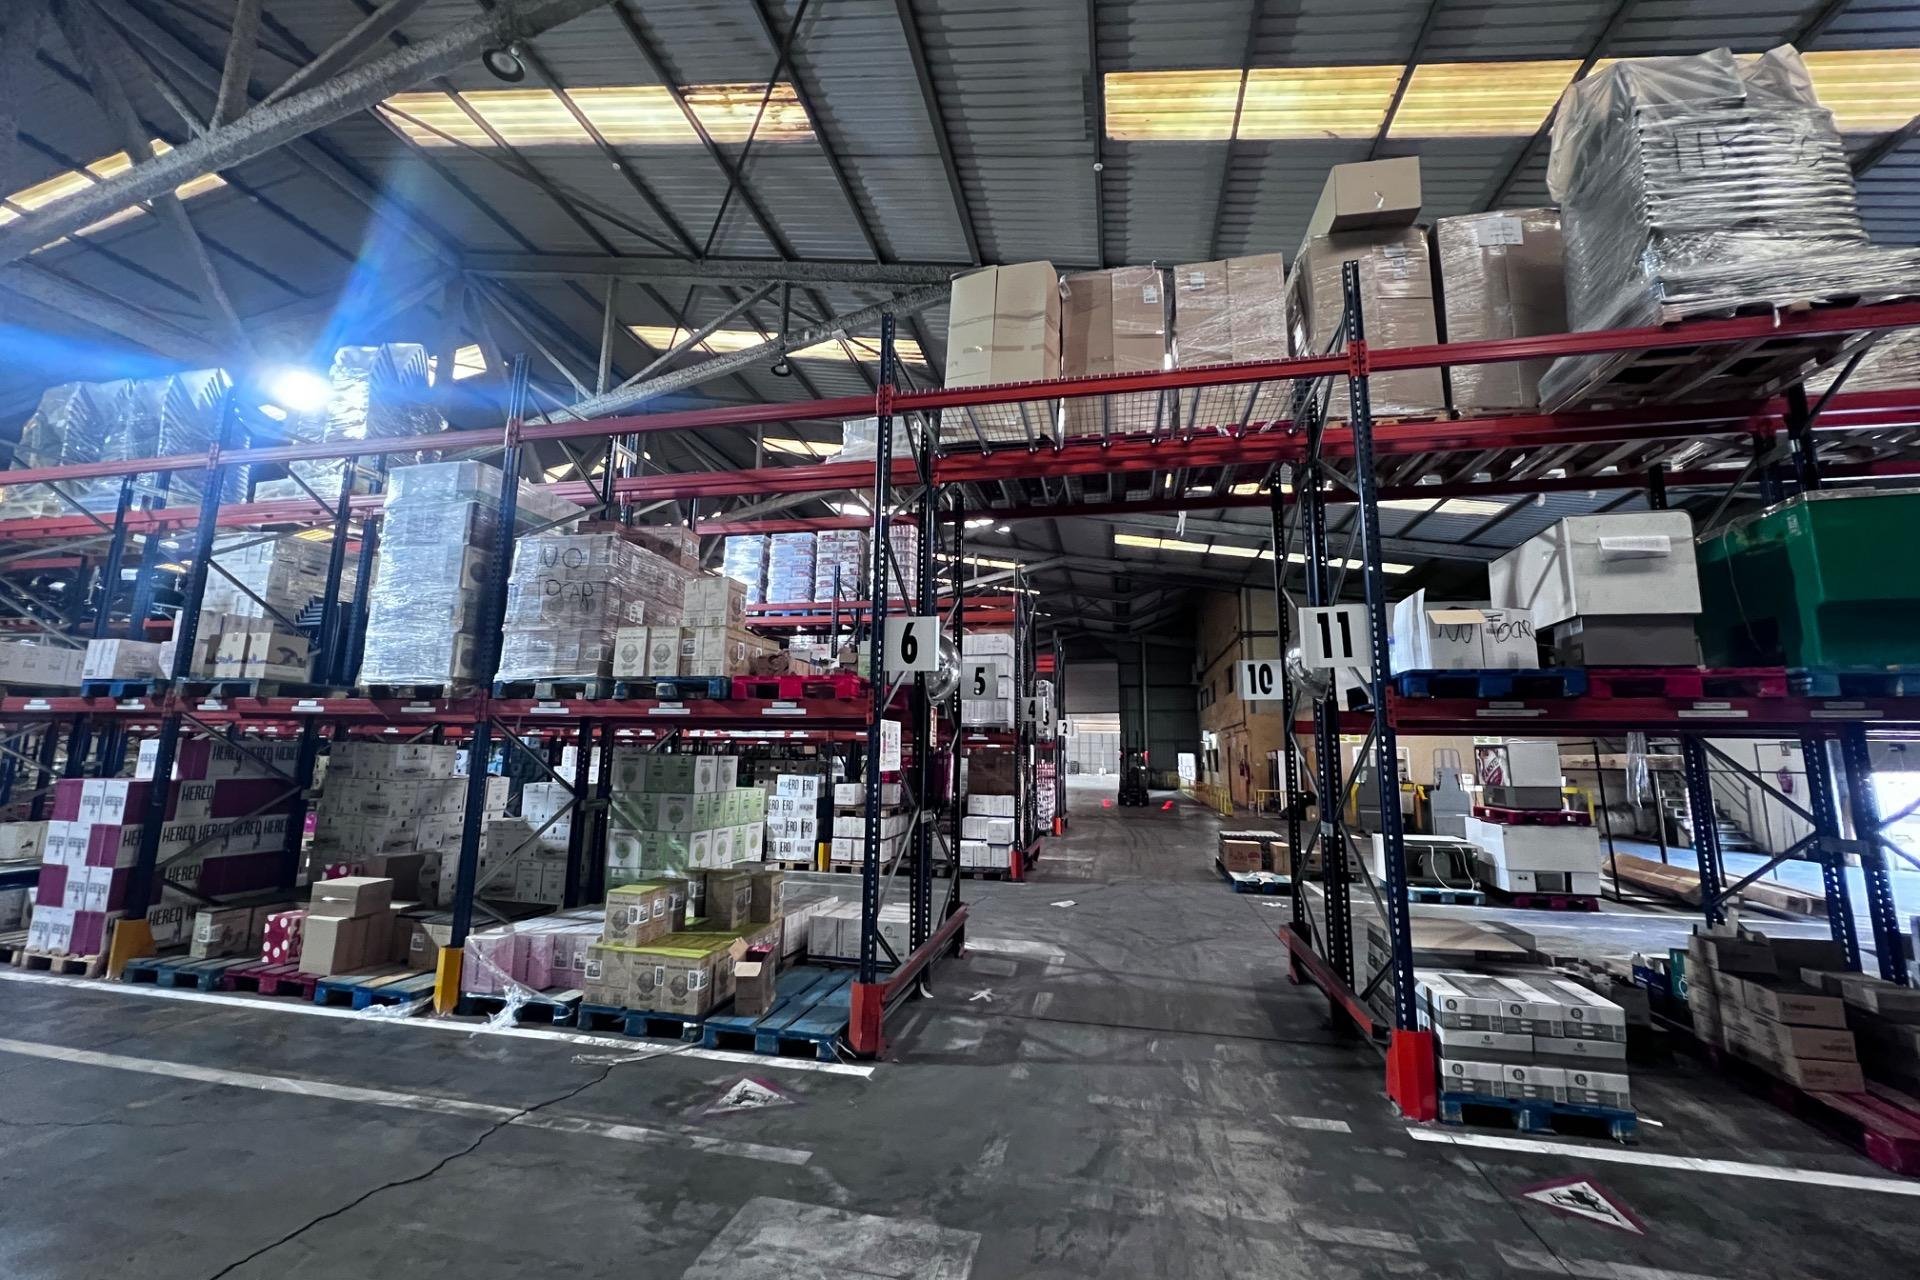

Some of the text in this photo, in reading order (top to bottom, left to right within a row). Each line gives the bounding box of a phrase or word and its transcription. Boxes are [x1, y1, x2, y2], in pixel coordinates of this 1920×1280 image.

[540, 546, 583, 569] NO
[901, 622, 918, 665] 6
[1317, 611, 1353, 658] 11
[973, 667, 986, 696] 5
[1247, 663, 1273, 695] 10
[1028, 700, 1036, 719] 4
[1062, 722, 1069, 734] 2
[181, 784, 214, 801] HERED
[162, 824, 195, 843] HERED
